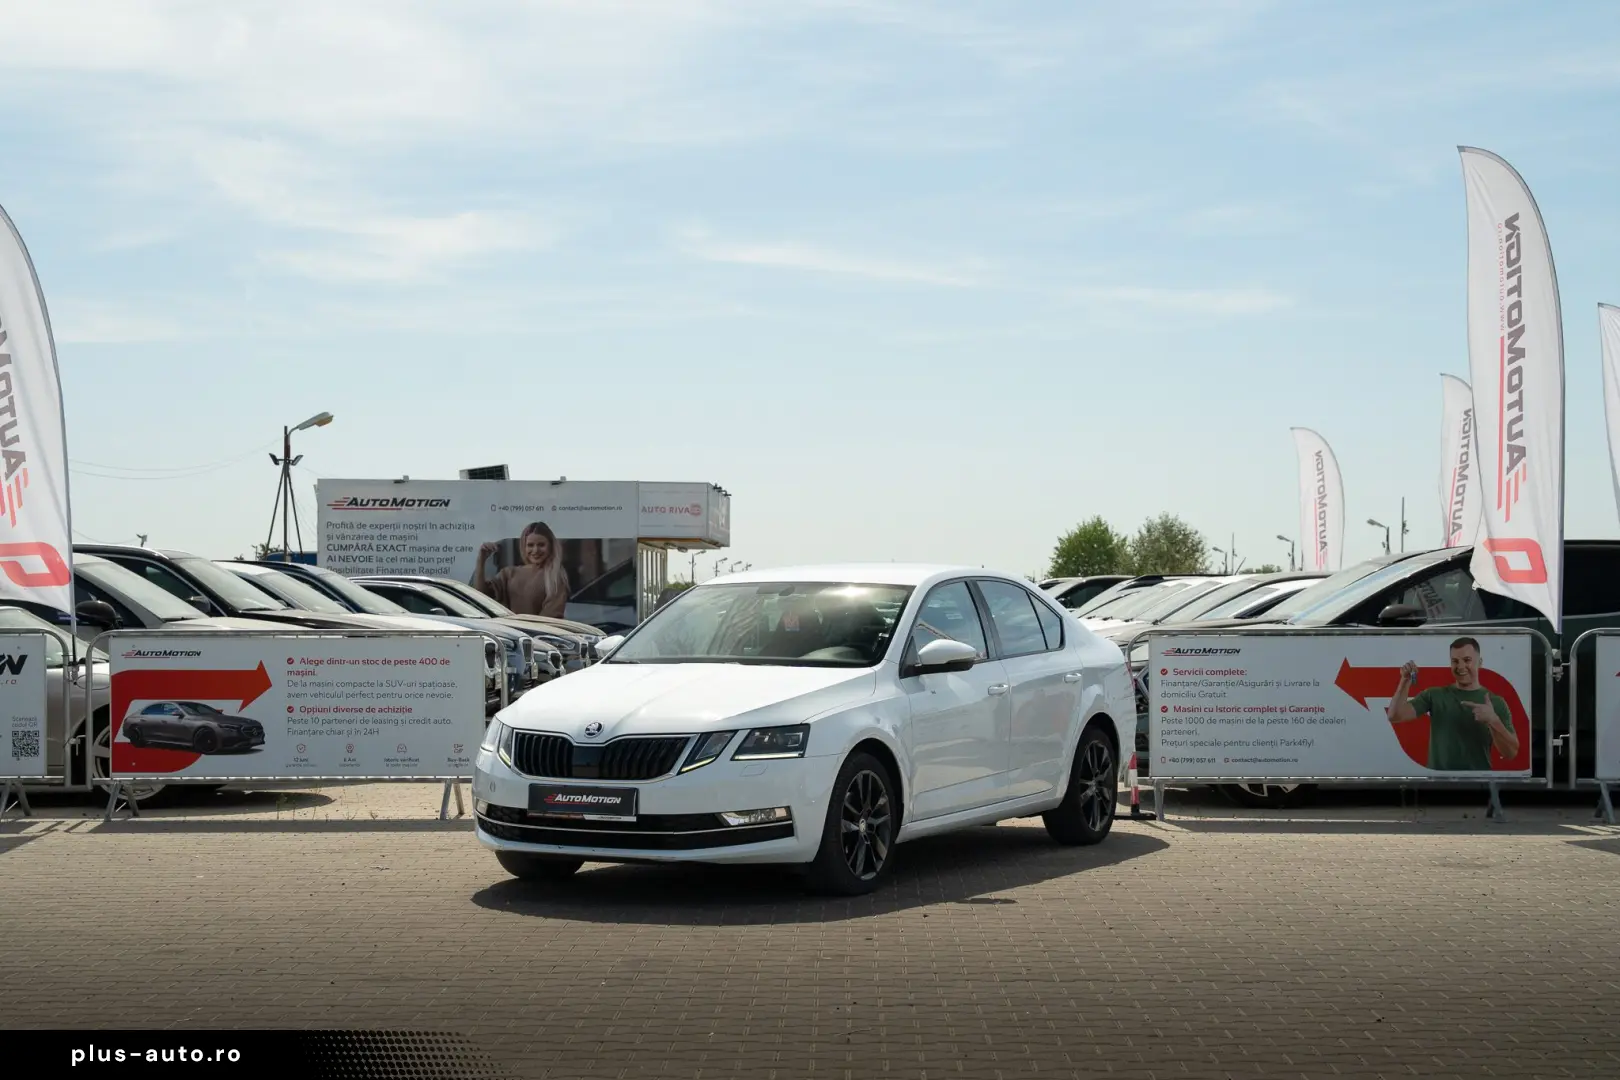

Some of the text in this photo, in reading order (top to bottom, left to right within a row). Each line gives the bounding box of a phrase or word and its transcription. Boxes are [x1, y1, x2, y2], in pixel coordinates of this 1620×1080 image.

[347, 497, 452, 508] AUTOMOTION
[641, 506, 690, 514] AUTO RIVA
[356, 521, 367, 530] de
[377, 532, 387, 541] de
[327, 543, 374, 552] CUMPĂRĂ
[376, 544, 408, 552] EXACT
[442, 544, 453, 553] de
[376, 555, 384, 563] la
[385, 555, 398, 563] cel
[418, 555, 434, 563] bun
[134, 649, 202, 657] AUTOMOTION
[299, 658, 324, 666] Alege
[326, 657, 360, 665] dintr-un
[394, 658, 417, 667] peste
[1173, 668, 1248, 678] Servicii complete:
[287, 680, 298, 688] De
[335, 681, 375, 690] compacte
[377, 680, 384, 688] la
[385, 680, 417, 688] SUV-uri
[1313, 679, 1320, 687] la
[310, 691, 344, 699] vehiculul
[345, 691, 375, 701] perfect
[376, 692, 403, 701] pentru
[1161, 691, 1196, 699] domiciliu
[1243, 706, 1278, 715] complet
[287, 717, 308, 725] Peste
[310, 717, 320, 725] 10
[322, 718, 358, 727] parteneri
[360, 717, 370, 725] de
[372, 717, 399, 727] leasing
[408, 717, 431, 725] credit
[1161, 717, 1183, 725] Peste
[1185, 717, 1205, 725] 1000
[1207, 717, 1217, 725] de
[1246, 717, 1256, 725] de
[1258, 717, 1265, 725] la
[1267, 718, 1289, 727] peste
[1291, 717, 1305, 725] 160
[1307, 717, 1317, 725] de
[1319, 717, 1347, 725] dealeri
[325, 728, 346, 736] chiar
[363, 728, 380, 736] 24H
[1189, 739, 1222, 748] speciale
[1223, 740, 1250, 748] pentru
[554, 793, 622, 804] AUTOMOTION
